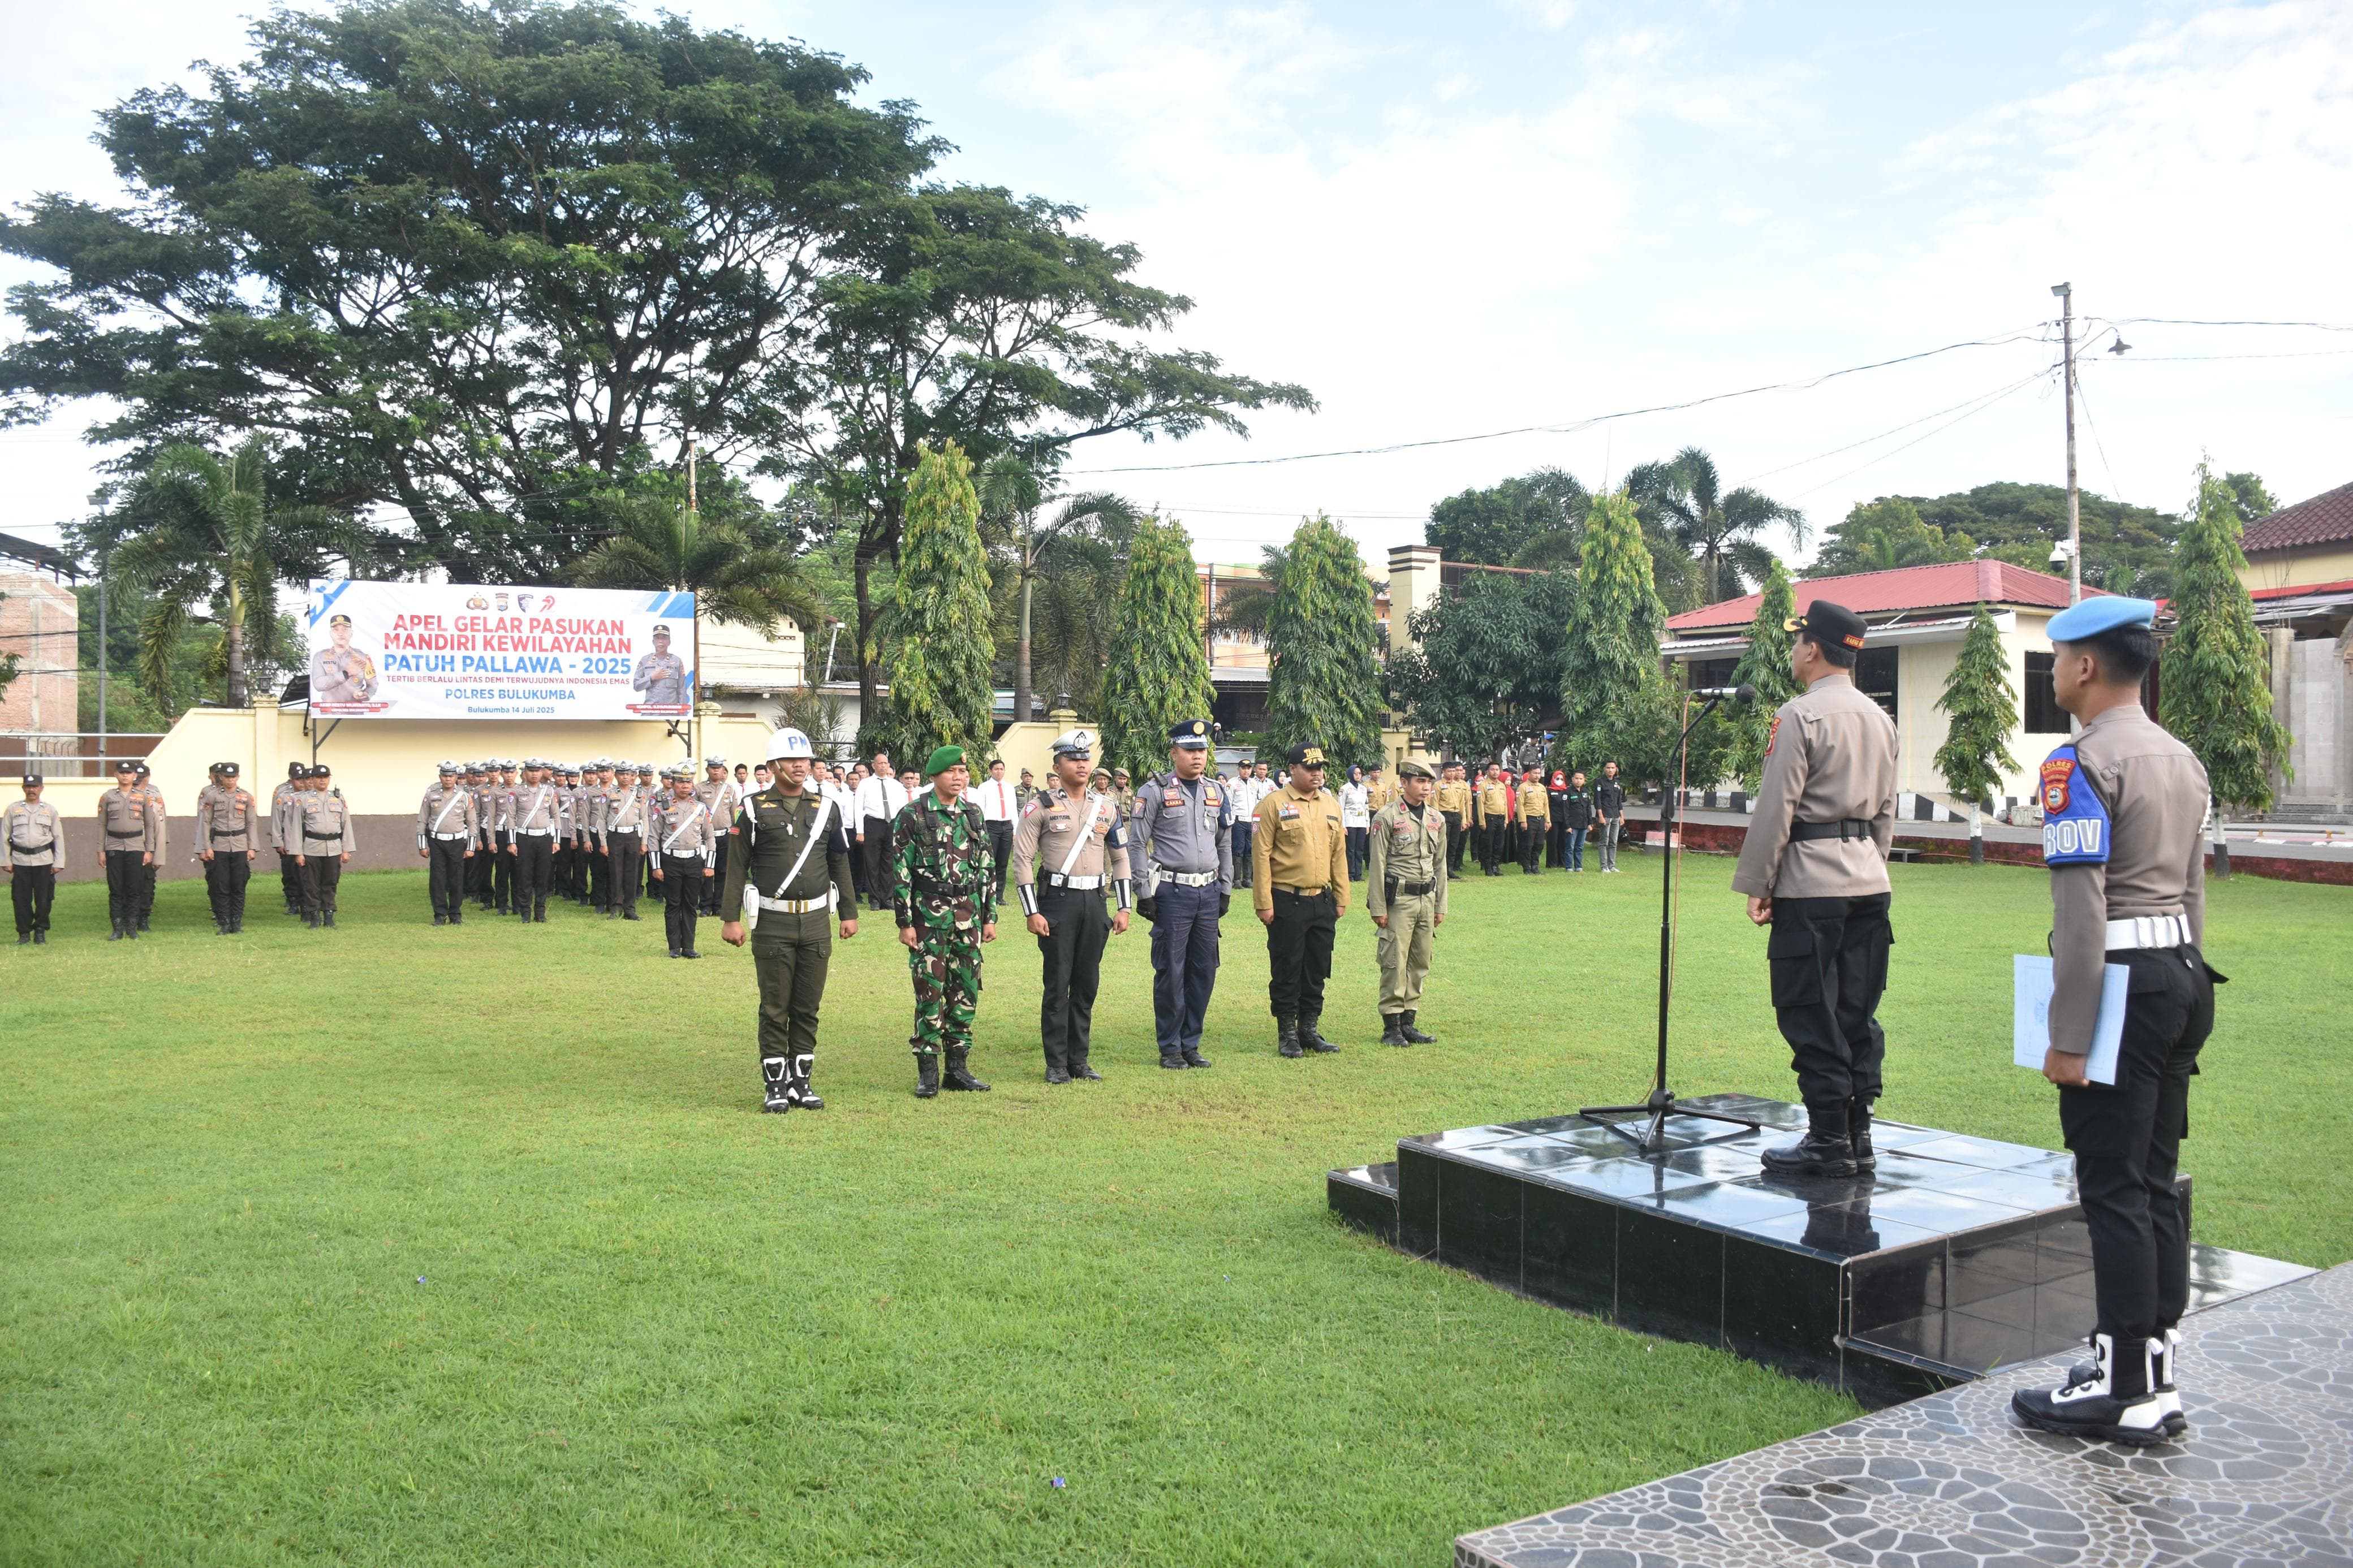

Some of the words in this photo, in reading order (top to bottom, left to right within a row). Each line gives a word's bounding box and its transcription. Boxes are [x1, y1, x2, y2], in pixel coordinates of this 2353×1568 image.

[393, 614, 448, 632] APEL
[454, 616, 523, 633] GELAR
[529, 617, 624, 636] PASUKAN
[385, 633, 476, 651] MANDIRI
[483, 635, 631, 654] KEWILAYAHAN
[385, 654, 455, 672] PATUH
[462, 655, 563, 673] PALLAWA
[583, 658, 631, 674] 2025
[445, 689, 494, 699] POLRES
[498, 689, 575, 700] BULUKUMBA
[788, 736, 808, 750] PM
[2042, 761, 2072, 772] POLRES
